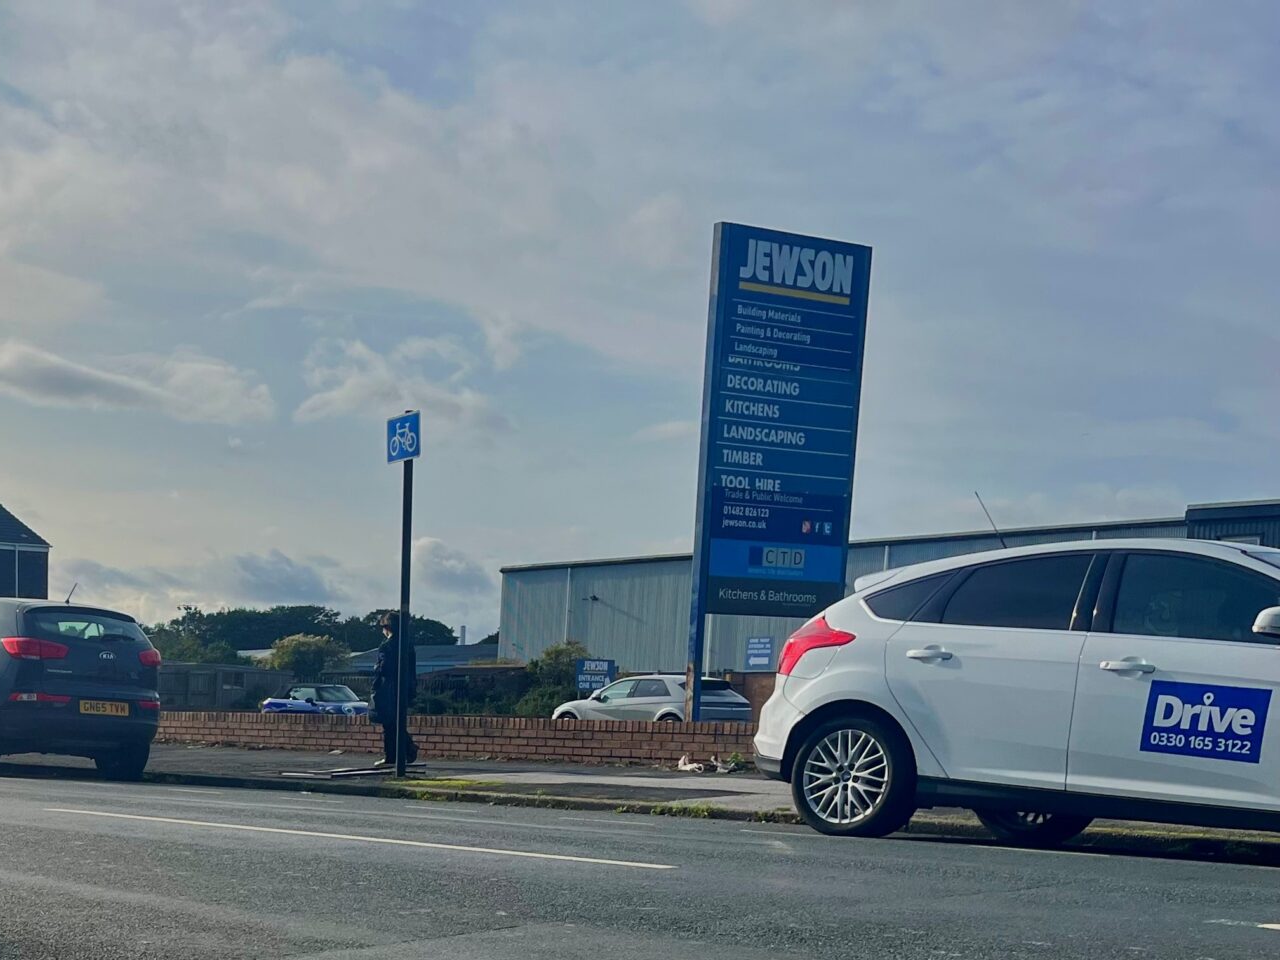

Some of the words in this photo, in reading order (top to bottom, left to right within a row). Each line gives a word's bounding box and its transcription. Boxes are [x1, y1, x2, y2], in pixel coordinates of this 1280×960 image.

[739, 238, 854, 295] JEWSON
[737, 304, 767, 320] Building
[768, 309, 802, 323] Materials
[736, 323, 765, 338] Painting
[766, 327, 771, 337] &
[773, 328, 811, 345] Decorating
[734, 342, 778, 358] Landscaping
[726, 374, 800, 396] DECORATING
[725, 399, 780, 418] KITCHENS
[723, 424, 806, 446] LANDSCAPING
[722, 449, 763, 466] TIMBER
[720, 474, 750, 490] TOOL
[755, 478, 781, 492] HIRE
[725, 489, 744, 499] Trade
[744, 491, 750, 499] &
[752, 491, 773, 502] Public
[773, 493, 803, 504] Welcome
[723, 505, 744, 516] 01482
[722, 518, 767, 529] jewson.co.uk
[765, 549, 803, 565] CTD
[718, 588, 758, 600] Kitchens
[760, 590, 767, 600] &
[768, 590, 817, 604] Bathrooms
[584, 660, 609, 671] JEWSON
[578, 674, 605, 682] ENTRANCE
[1152, 692, 1256, 735] Drive
[1150, 731, 1185, 747] 0330
[1188, 735, 1213, 750] 165
[1215, 738, 1251, 754] 3122
